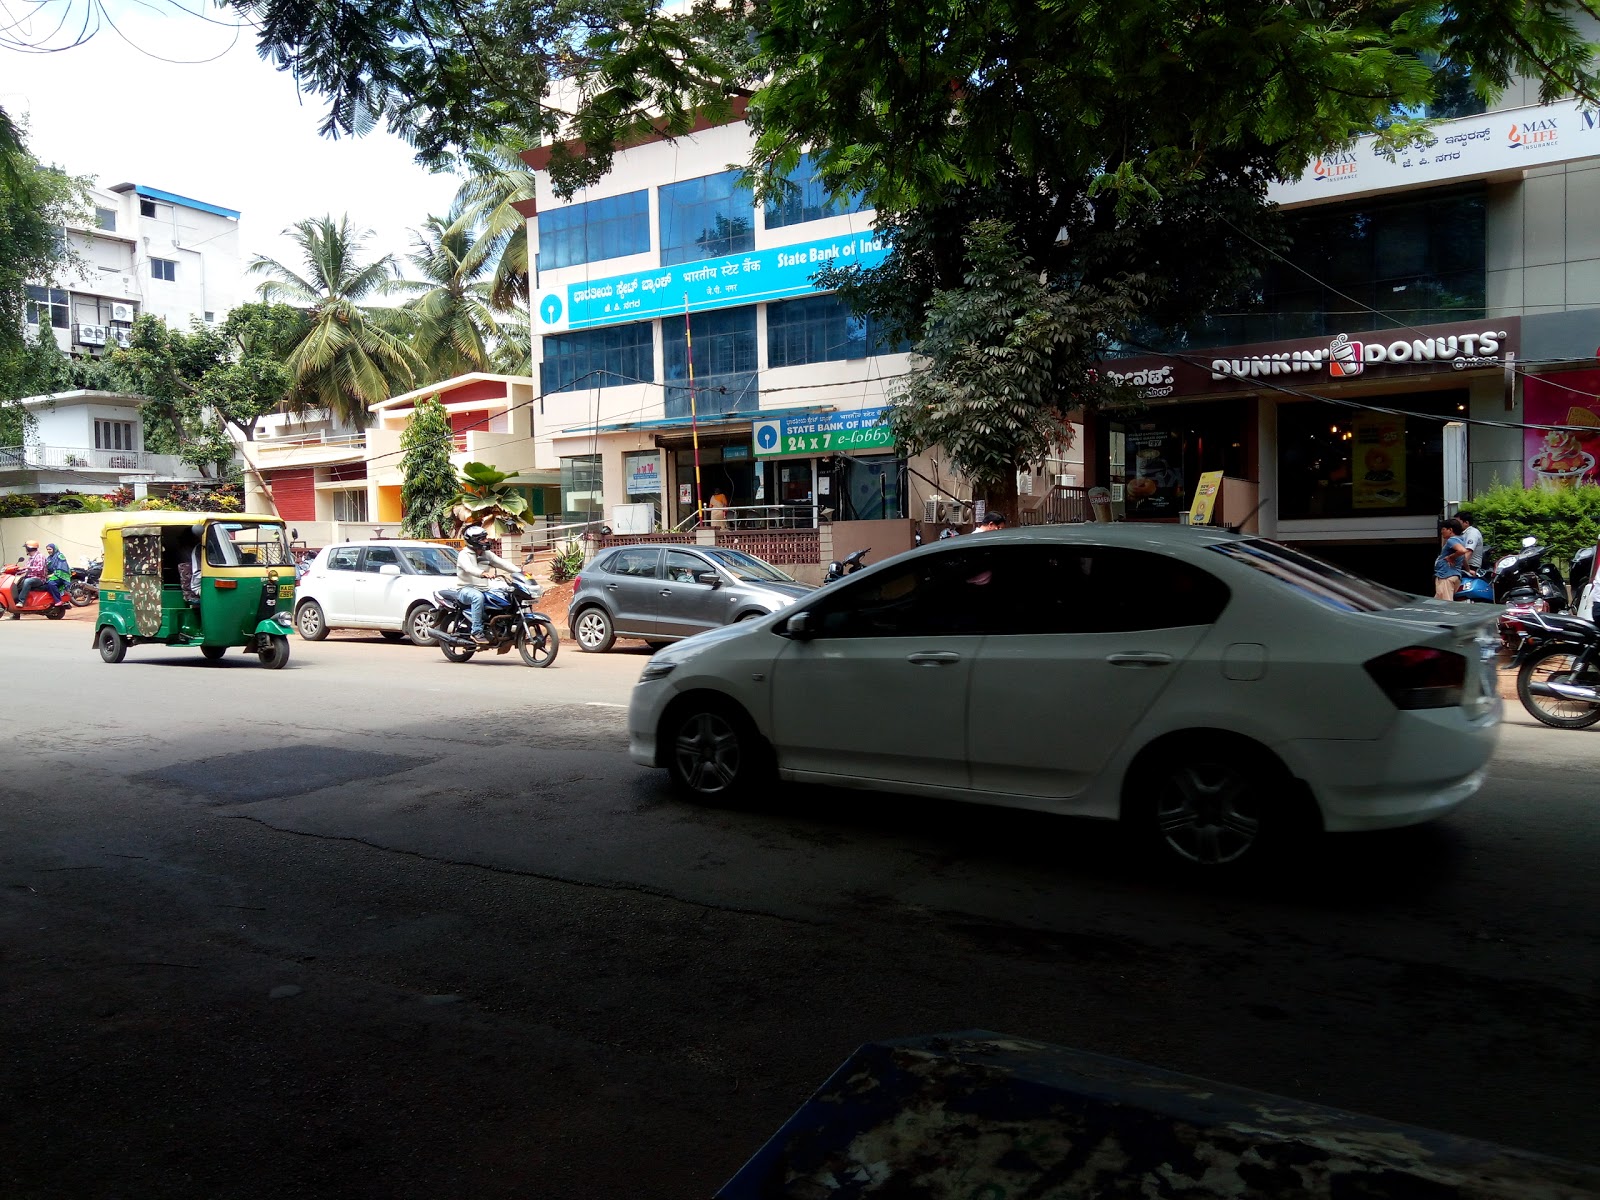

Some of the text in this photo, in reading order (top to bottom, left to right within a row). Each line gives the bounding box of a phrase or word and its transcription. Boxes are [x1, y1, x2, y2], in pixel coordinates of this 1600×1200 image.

[1523, 118, 1557, 133] MAX
[1523, 130, 1558, 145] LIFE
[1523, 141, 1558, 150] INSURANCE
[1327, 152, 1357, 167] MAX
[1435, 152, 1460, 163] ನಗರ
[1327, 162, 1358, 177] LIFE
[1327, 174, 1358, 182] INSURANCE
[777, 251, 808, 268] State
[809, 243, 840, 262] Bank
[842, 240, 856, 256] of
[683, 257, 761, 282] भारतीय स्टेट बैंक
[573, 284, 613, 304] ಭಾರತೀಯ
[725, 283, 738, 293] नगर
[1211, 347, 1330, 381] DUNKIN'
[787, 424, 816, 435] STATE
[817, 421, 843, 432] BANK
[846, 420, 859, 429] OF
[788, 435, 806, 451] 24
[823, 433, 832, 449] 7
[838, 427, 890, 445] e-lobby
